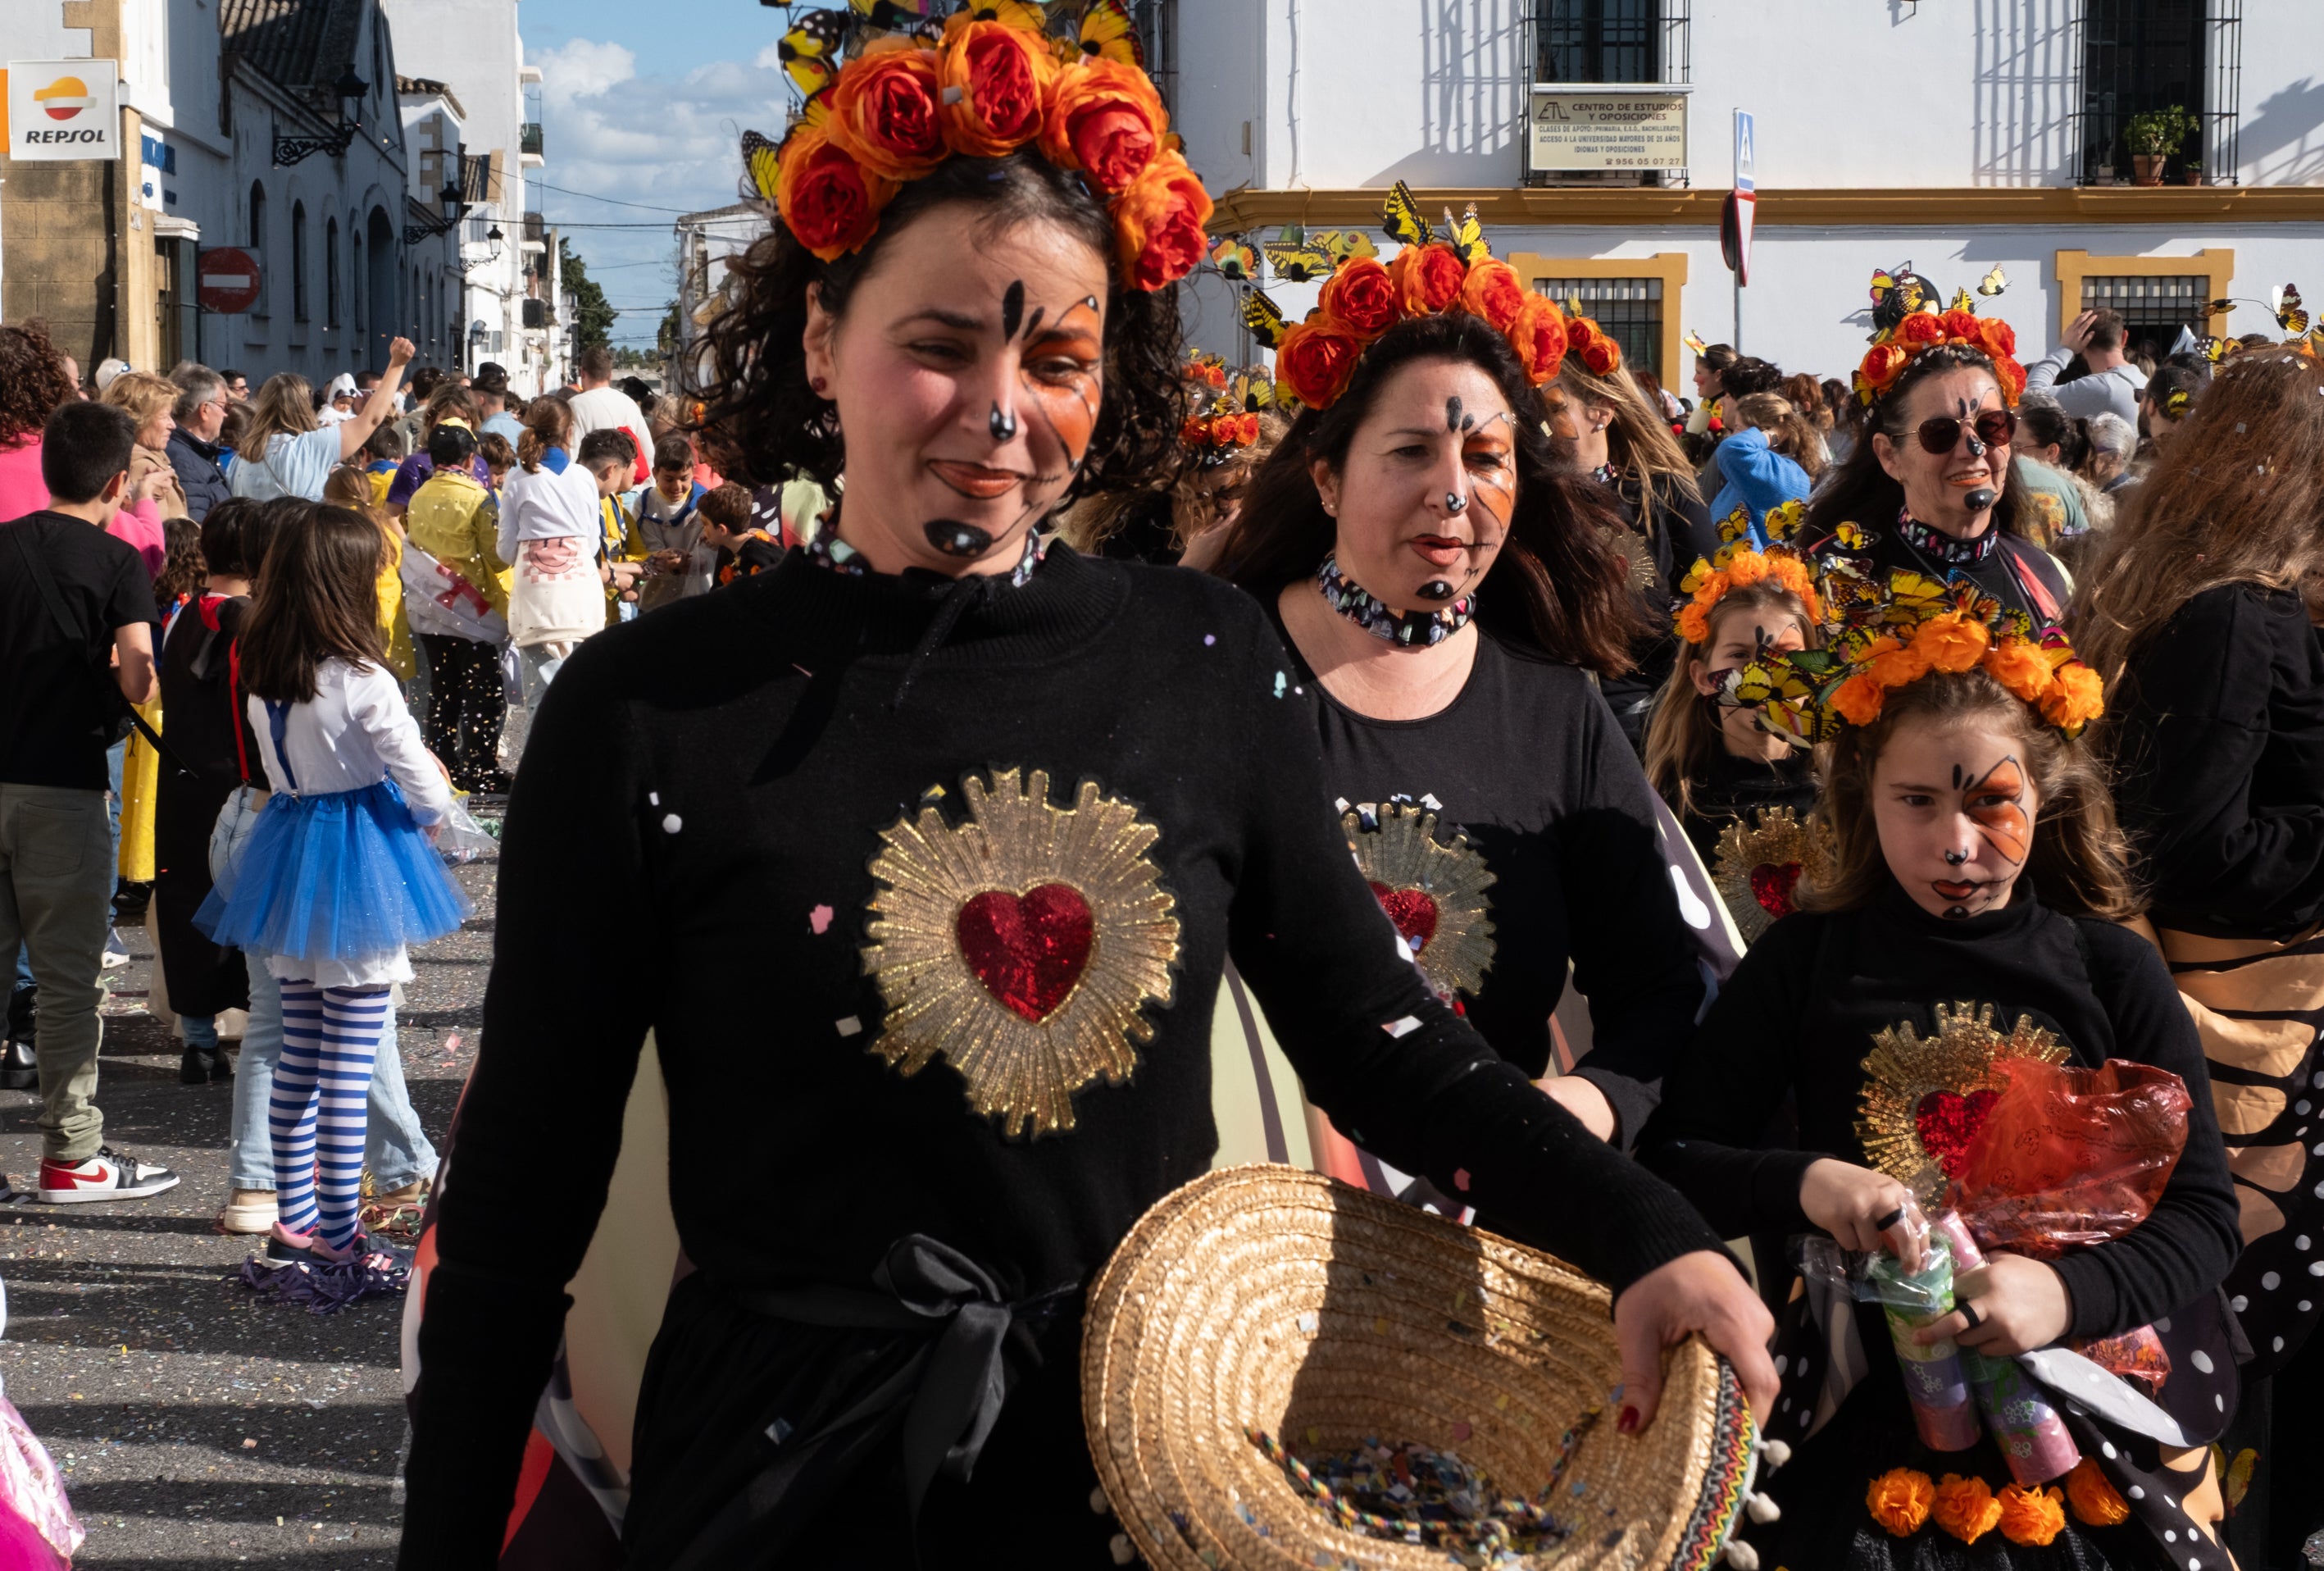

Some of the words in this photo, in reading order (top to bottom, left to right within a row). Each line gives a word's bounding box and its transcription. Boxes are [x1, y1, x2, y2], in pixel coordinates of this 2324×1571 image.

[1572, 103, 1614, 112] CENTRO
[1619, 103, 1632, 112] DE
[1635, 103, 1683, 112] ESTUDIOS
[25, 129, 106, 143] REPSOL
[1665, 134, 1680, 143] AÑOS
